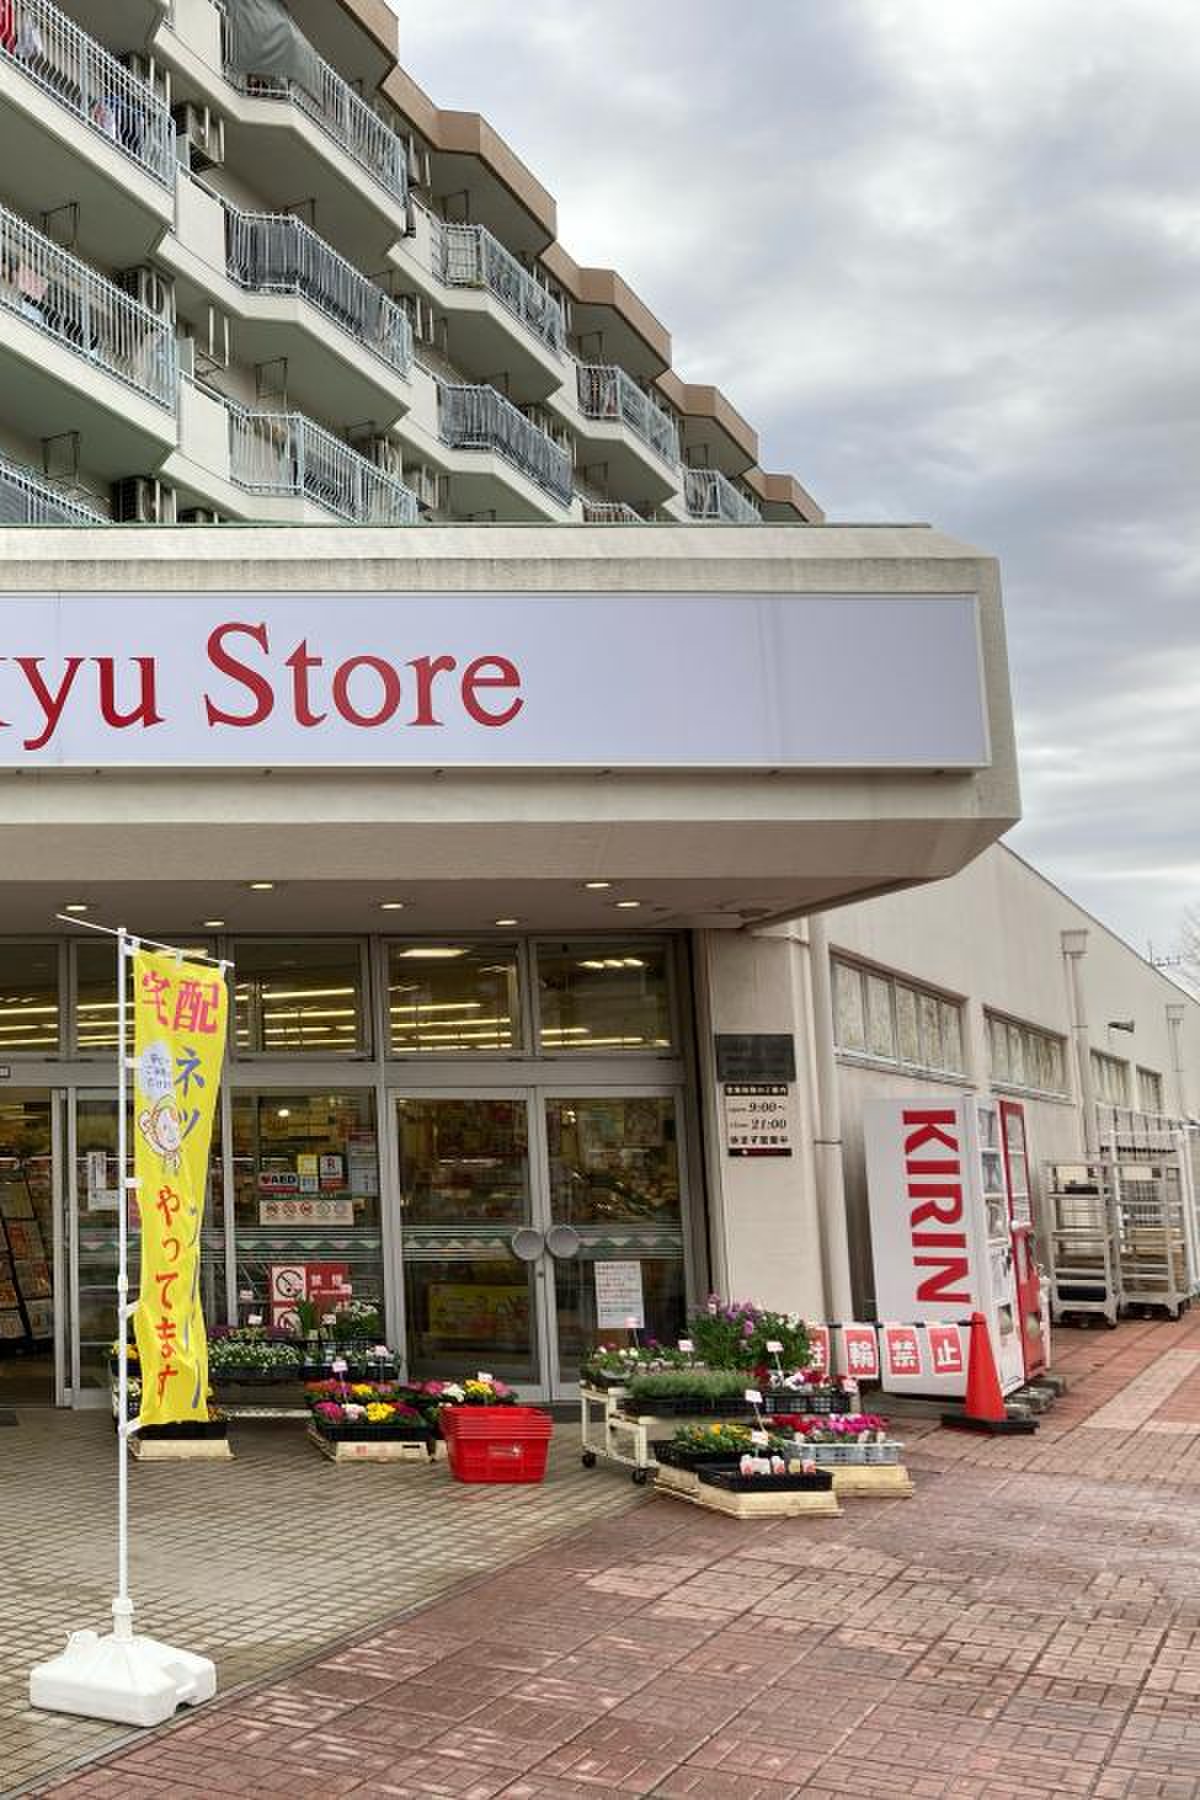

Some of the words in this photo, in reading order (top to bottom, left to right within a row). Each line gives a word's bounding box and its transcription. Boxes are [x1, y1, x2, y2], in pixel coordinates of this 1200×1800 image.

[203, 621, 525, 728] Store
[142, 969, 220, 1035] 宅配
[751, 1119, 787, 1130] 21:00
[271, 1174, 296, 1186] AED
[902, 1109, 972, 1304] KIRIN
[155, 1184, 181, 1409] やってます
